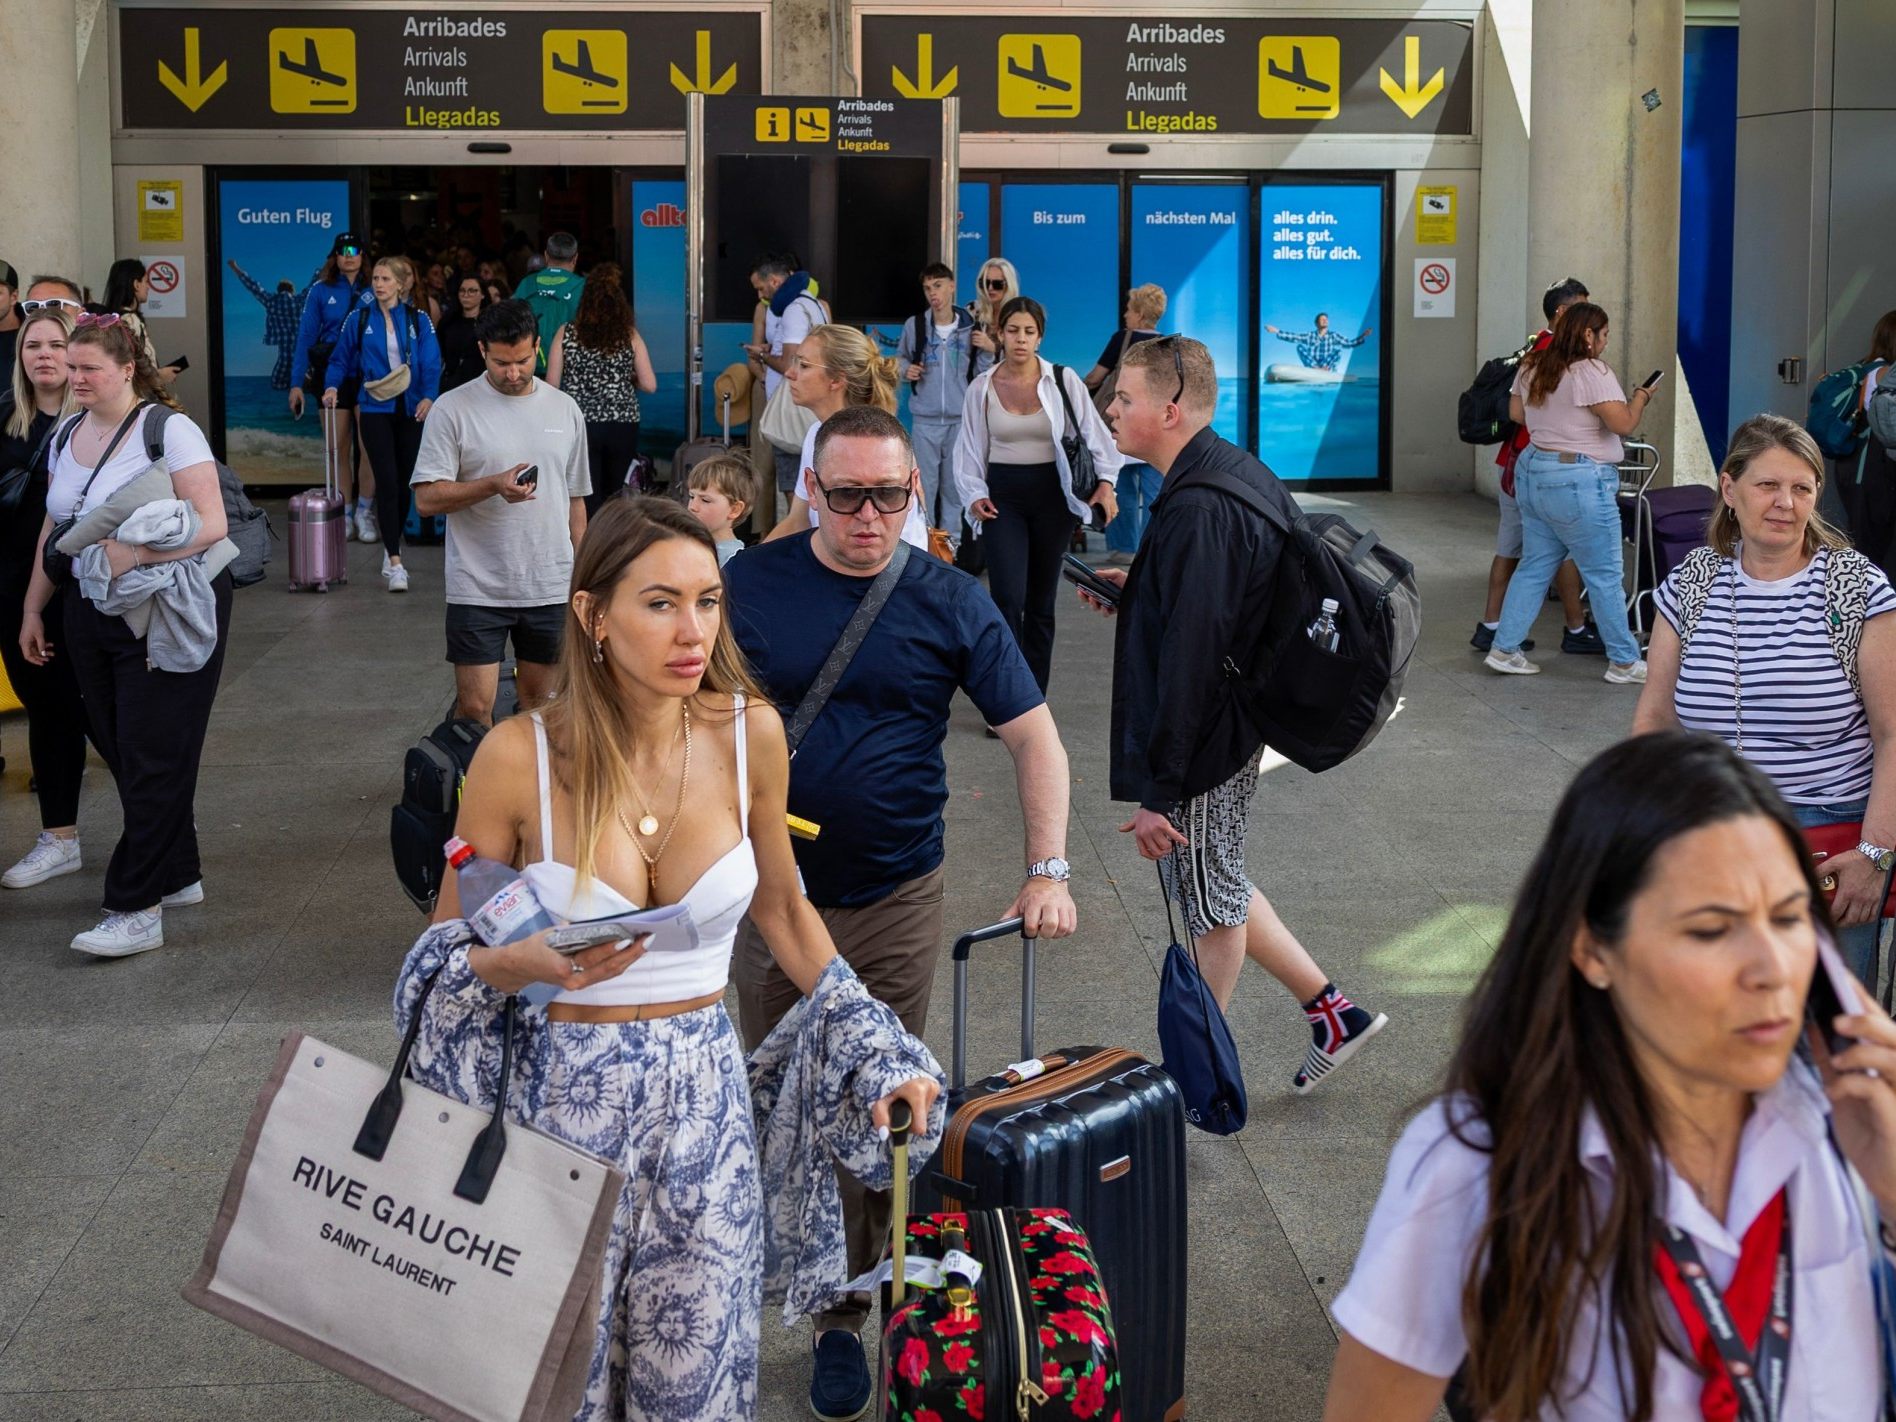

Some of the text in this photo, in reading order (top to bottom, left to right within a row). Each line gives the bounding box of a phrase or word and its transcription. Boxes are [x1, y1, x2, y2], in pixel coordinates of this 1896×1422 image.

[403, 16, 507, 37] Arribades
[1126, 23, 1225, 43] Arribades
[403, 46, 467, 66] Arrivals
[1126, 52, 1187, 72] Arrivals
[404, 76, 468, 96] Ankunft
[1126, 81, 1187, 101] Ankunft
[837, 99, 894, 112] Arribades
[405, 105, 501, 128] Llegadas
[837, 114, 873, 124] Arrivals
[1127, 110, 1217, 132] Llegadas
[838, 126, 873, 137] Ankunft
[838, 139, 890, 152] Llegadas
[238, 207, 332, 229] Guten Flug
[1033, 211, 1086, 225] Bis zum
[1146, 211, 1236, 225] nächsten Mal
[1273, 210, 1338, 224] alles drin.
[1273, 228, 1334, 245] alles gut.
[1273, 246, 1361, 260] alles für dich.
[292, 1156, 522, 1277] RIVE GAUCHE
[320, 1222, 457, 1296] SAINT LAURENT
